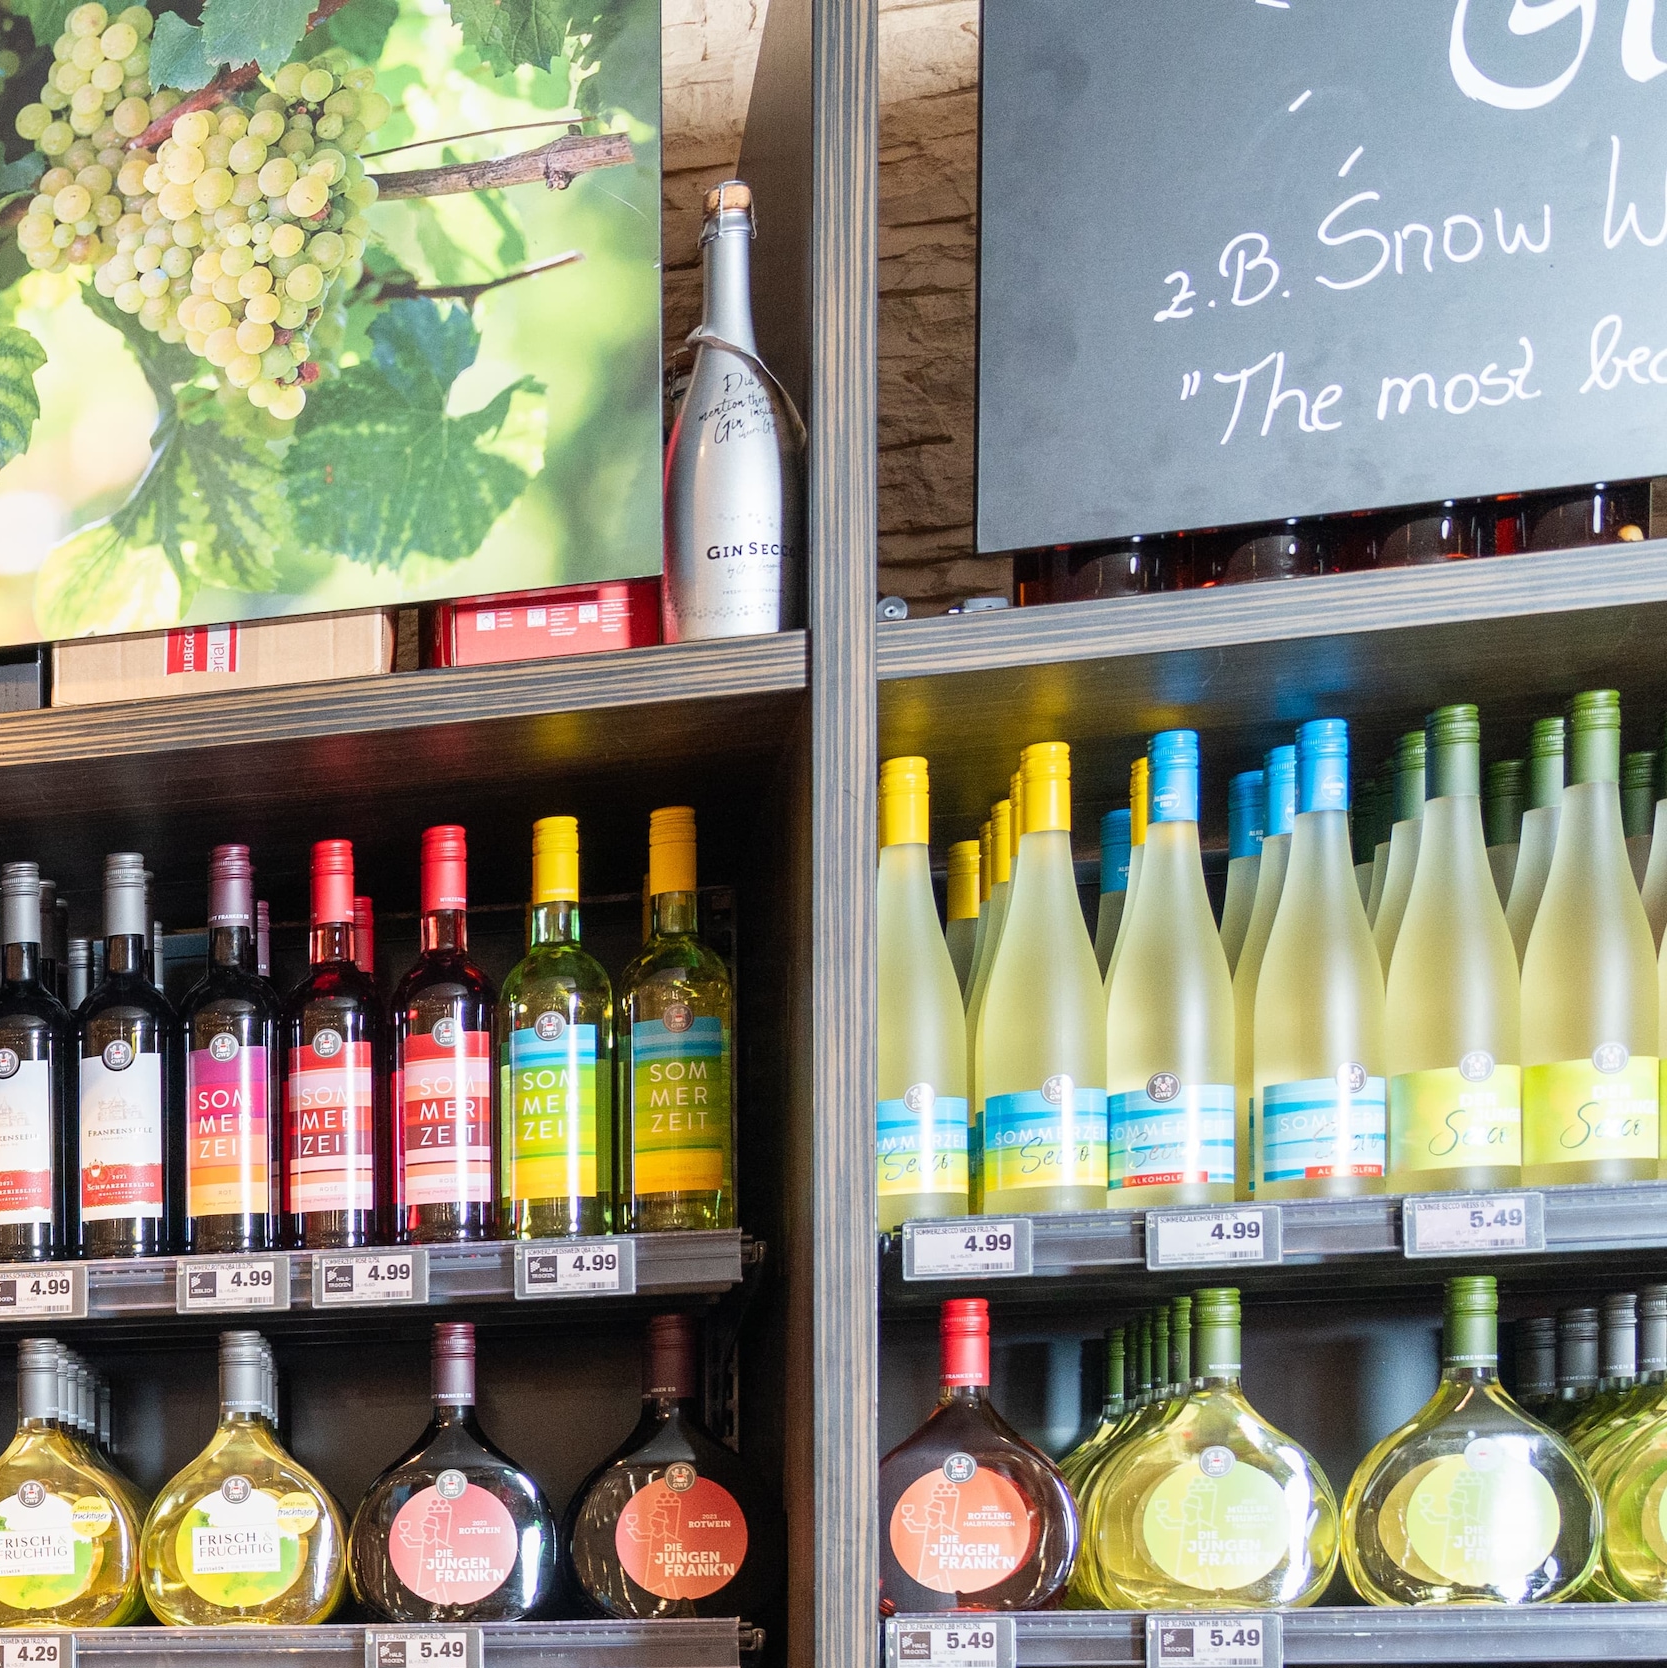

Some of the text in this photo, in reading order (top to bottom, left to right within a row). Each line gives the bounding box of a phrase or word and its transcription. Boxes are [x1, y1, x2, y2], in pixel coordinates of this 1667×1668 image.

[1153, 232, 1290, 323] z.B.
[1377, 336, 1542, 422] most
[1579, 315, 1667, 394] be
[706, 545, 743, 559] GIN
[649, 1063, 708, 1083] SOM
[650, 1087, 708, 1108] MER
[650, 1111, 708, 1133] ZEIT
[1470, 1209, 1523, 1228] 5.49
[1211, 1220, 1261, 1241] 4.99
[231, 1268, 273, 1288] 4.99
[29, 1278, 71, 1298] 4.99
[688, 1520, 731, 1529] ROTWEIN
[967, 1511, 1012, 1521] ROTLING
[939, 1534, 960, 1545] DIE
[929, 1543, 999, 1557] JUNGEN
[938, 1556, 1015, 1570] FRANK'N
[16, 1644, 58, 1663] 4.29
[420, 1640, 465, 1659] 5.49
